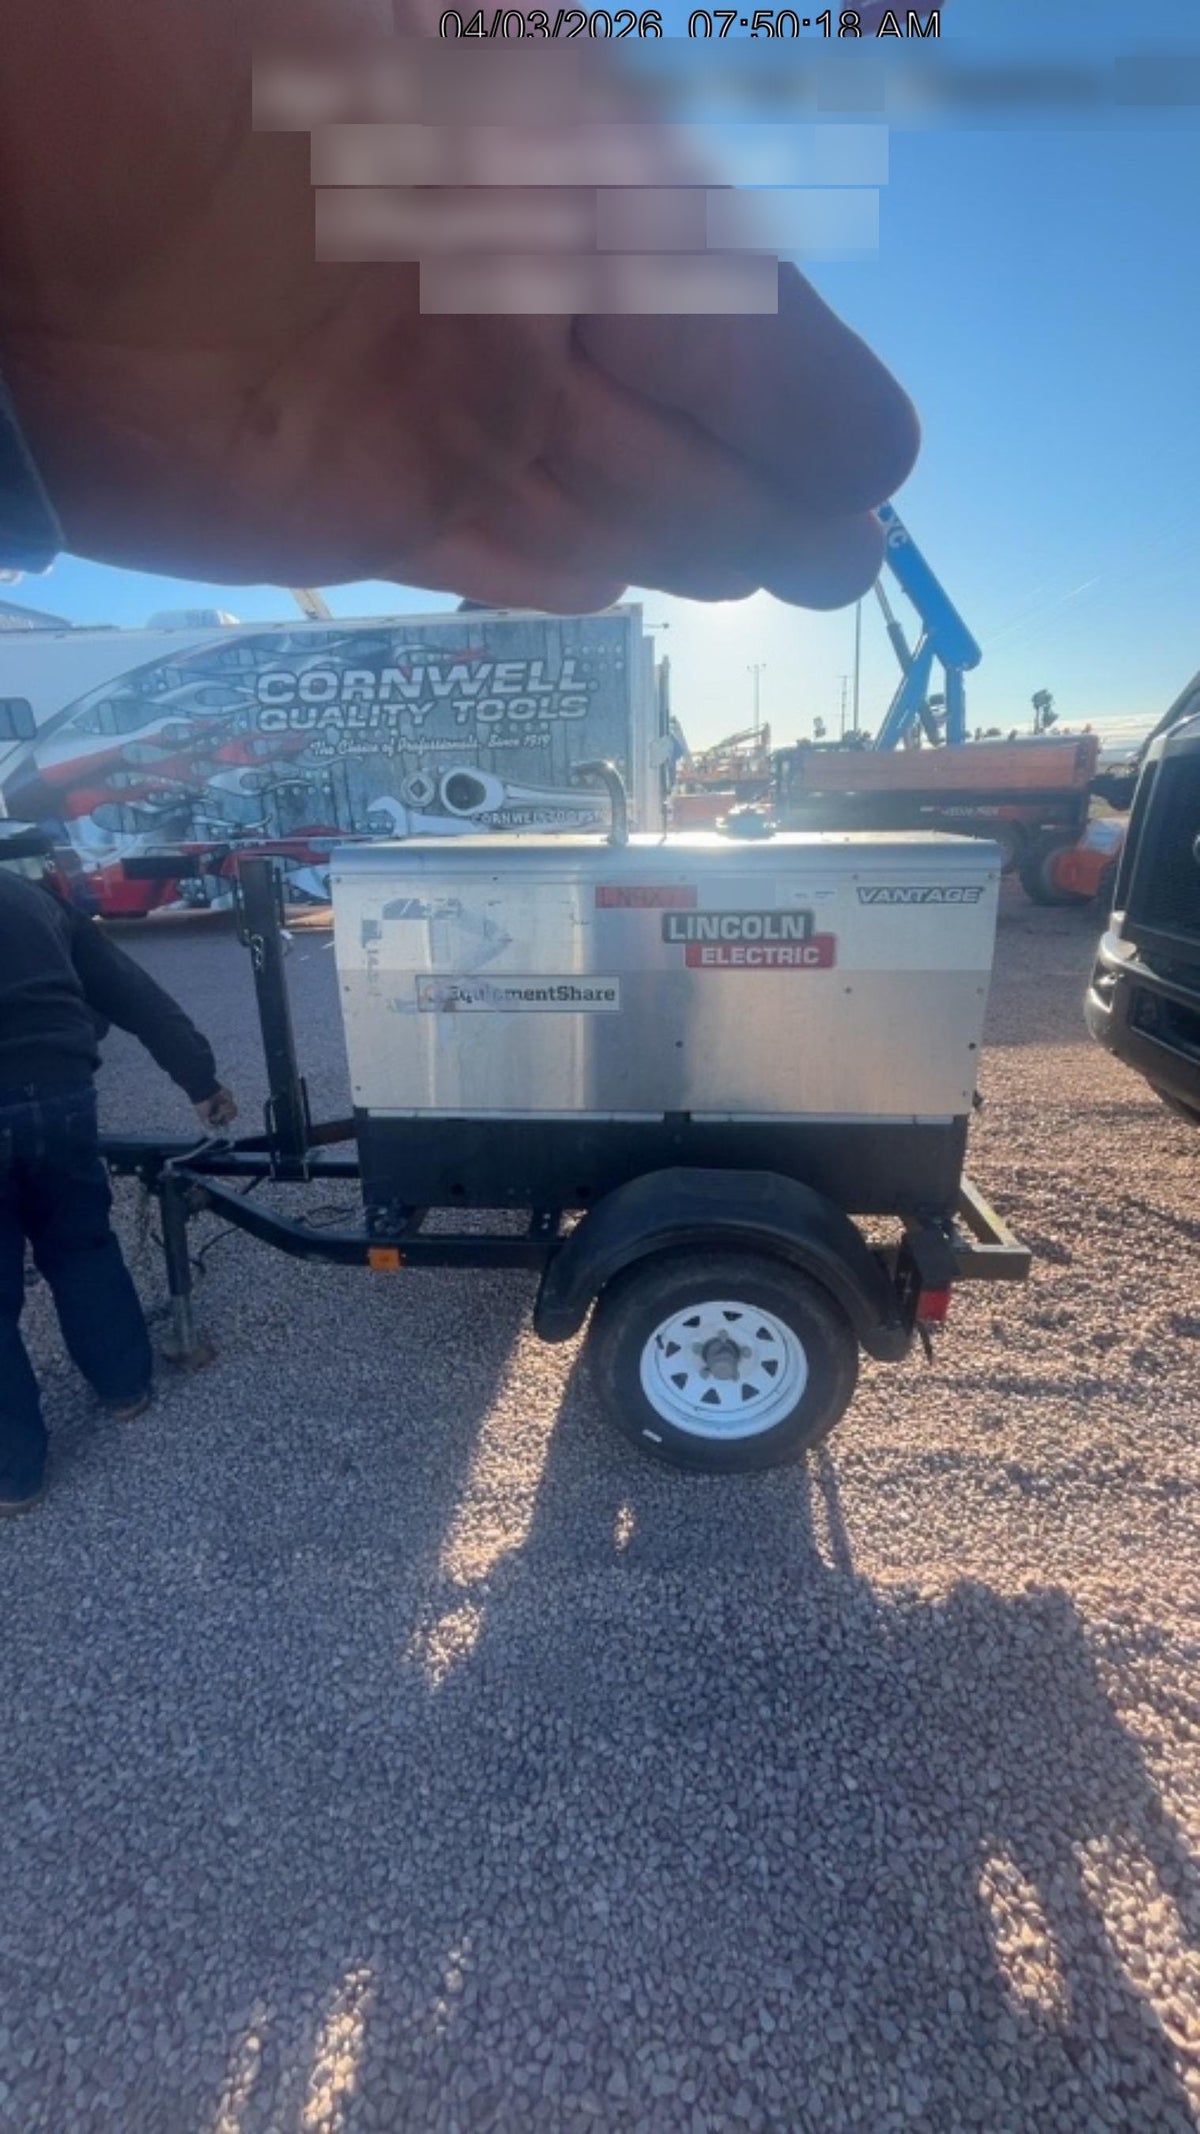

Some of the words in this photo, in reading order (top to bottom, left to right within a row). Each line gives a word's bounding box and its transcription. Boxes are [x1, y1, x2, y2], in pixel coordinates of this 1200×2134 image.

[256, 660, 588, 703] CORNWELL
[257, 702, 435, 732] QUALITY
[451, 695, 589, 723] TOOLS
[856, 886, 985, 904] VANTAGE
[669, 914, 806, 941] LINCOLN
[701, 946, 820, 965] ELECTRIC
